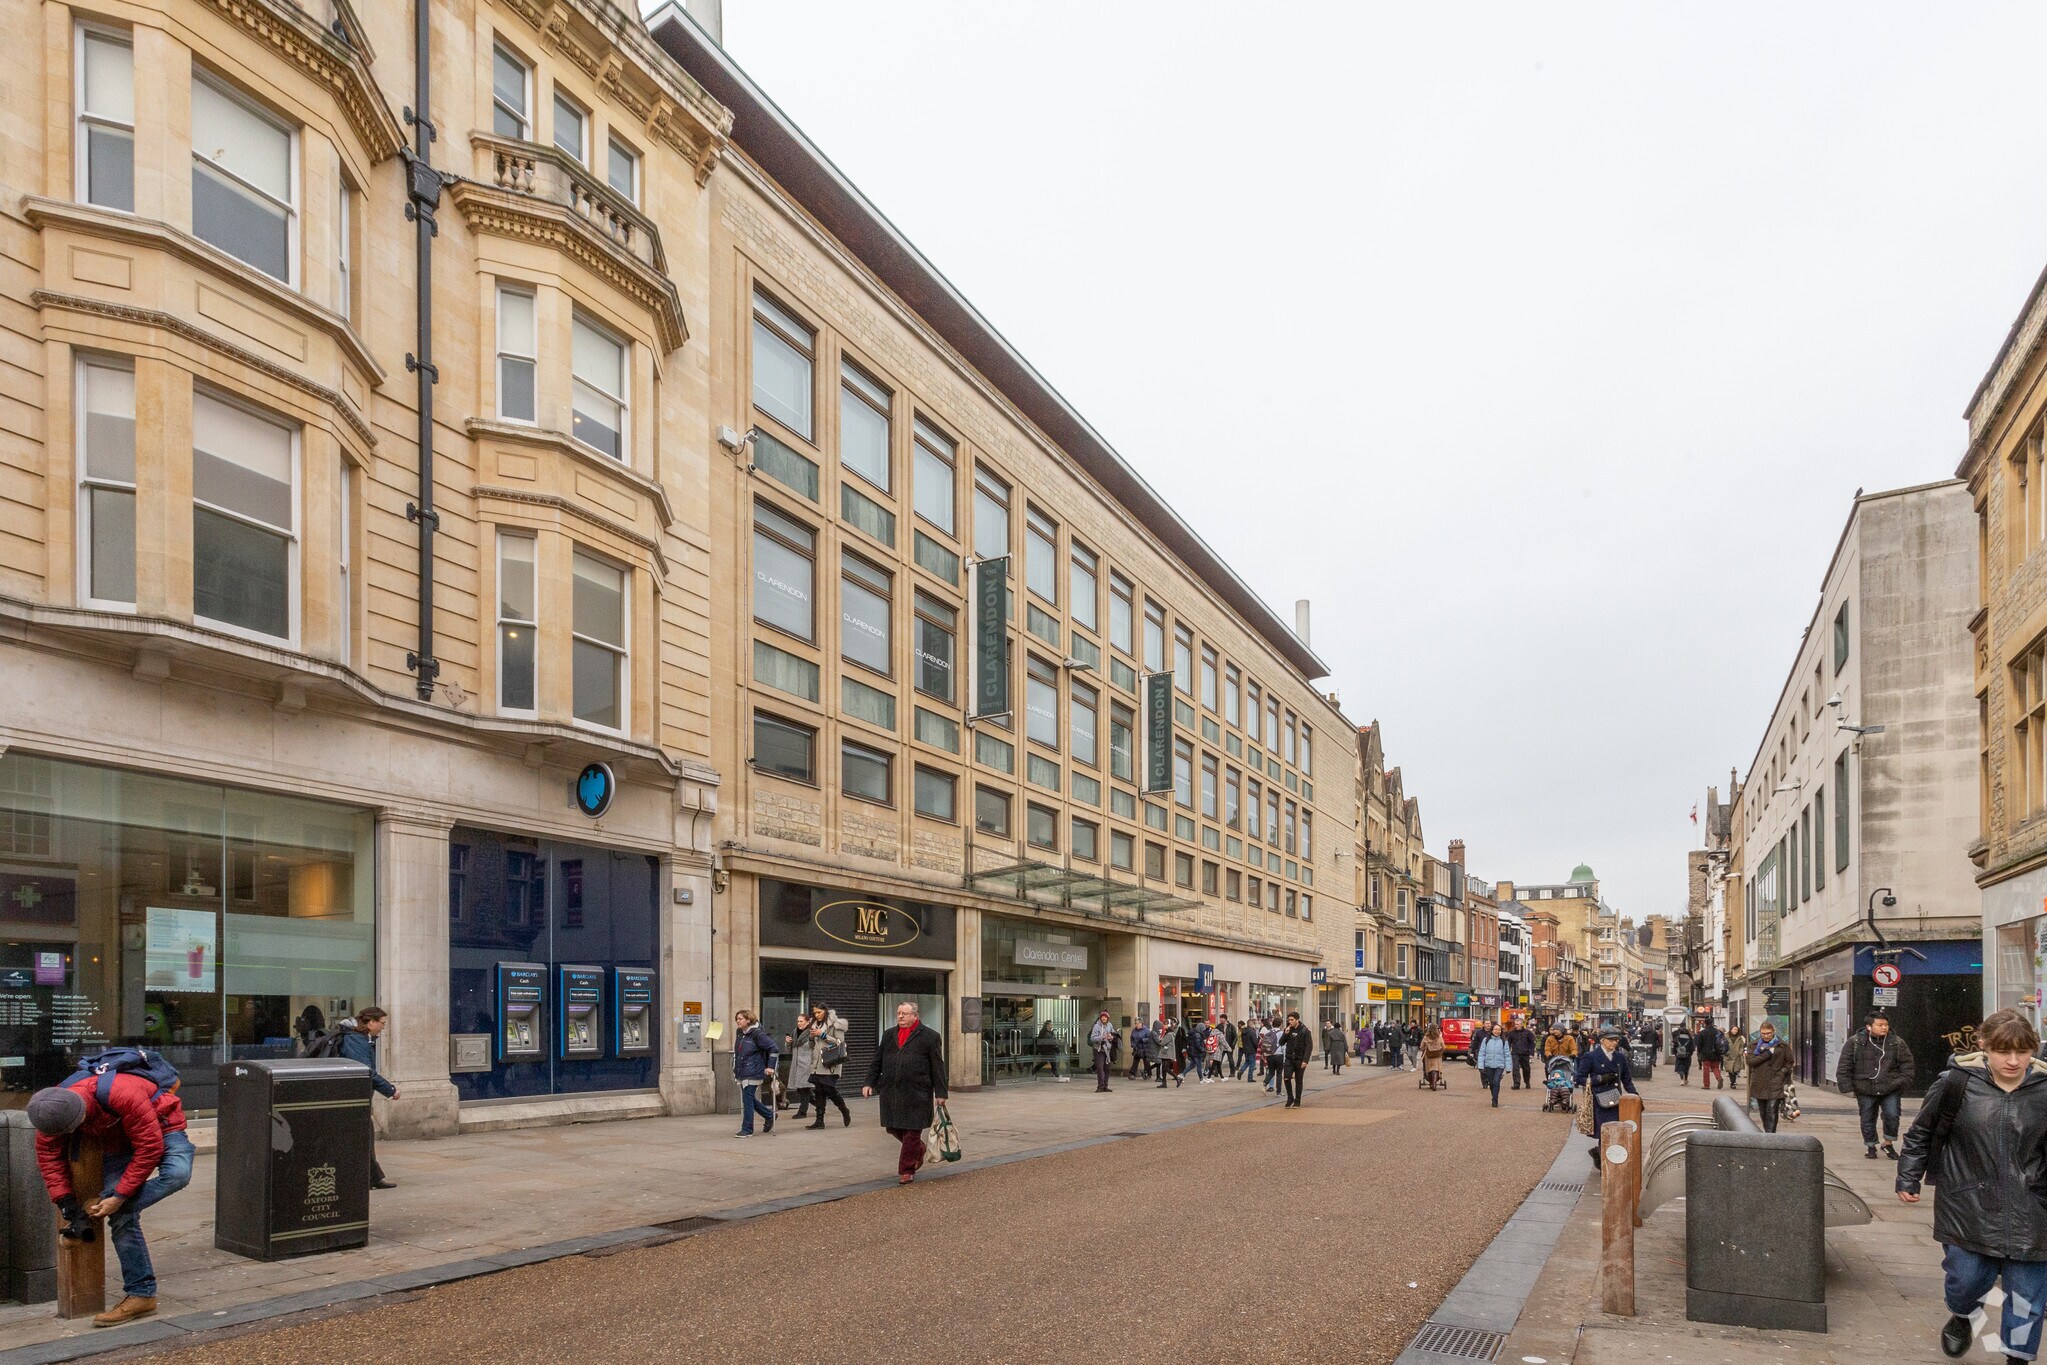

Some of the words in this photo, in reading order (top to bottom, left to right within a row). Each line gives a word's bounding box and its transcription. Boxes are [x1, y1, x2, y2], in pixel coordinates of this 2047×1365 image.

[758, 571, 807, 602] CLARENDON
[844, 613, 885, 639] CLARENDON
[985, 579, 998, 697] CLARENDON
[916, 648, 950, 670] CLARENDON
[1155, 687, 1165, 778] CLARENDON
[1023, 946, 1059, 962] Clarendon
[1061, 951, 1083, 965] Centre
[1312, 971, 1325, 981] GAP
[303, 1195, 339, 1205] OXFORD
[311, 1204, 332, 1212] CITY
[302, 1212, 341, 1222] COUNCIL
